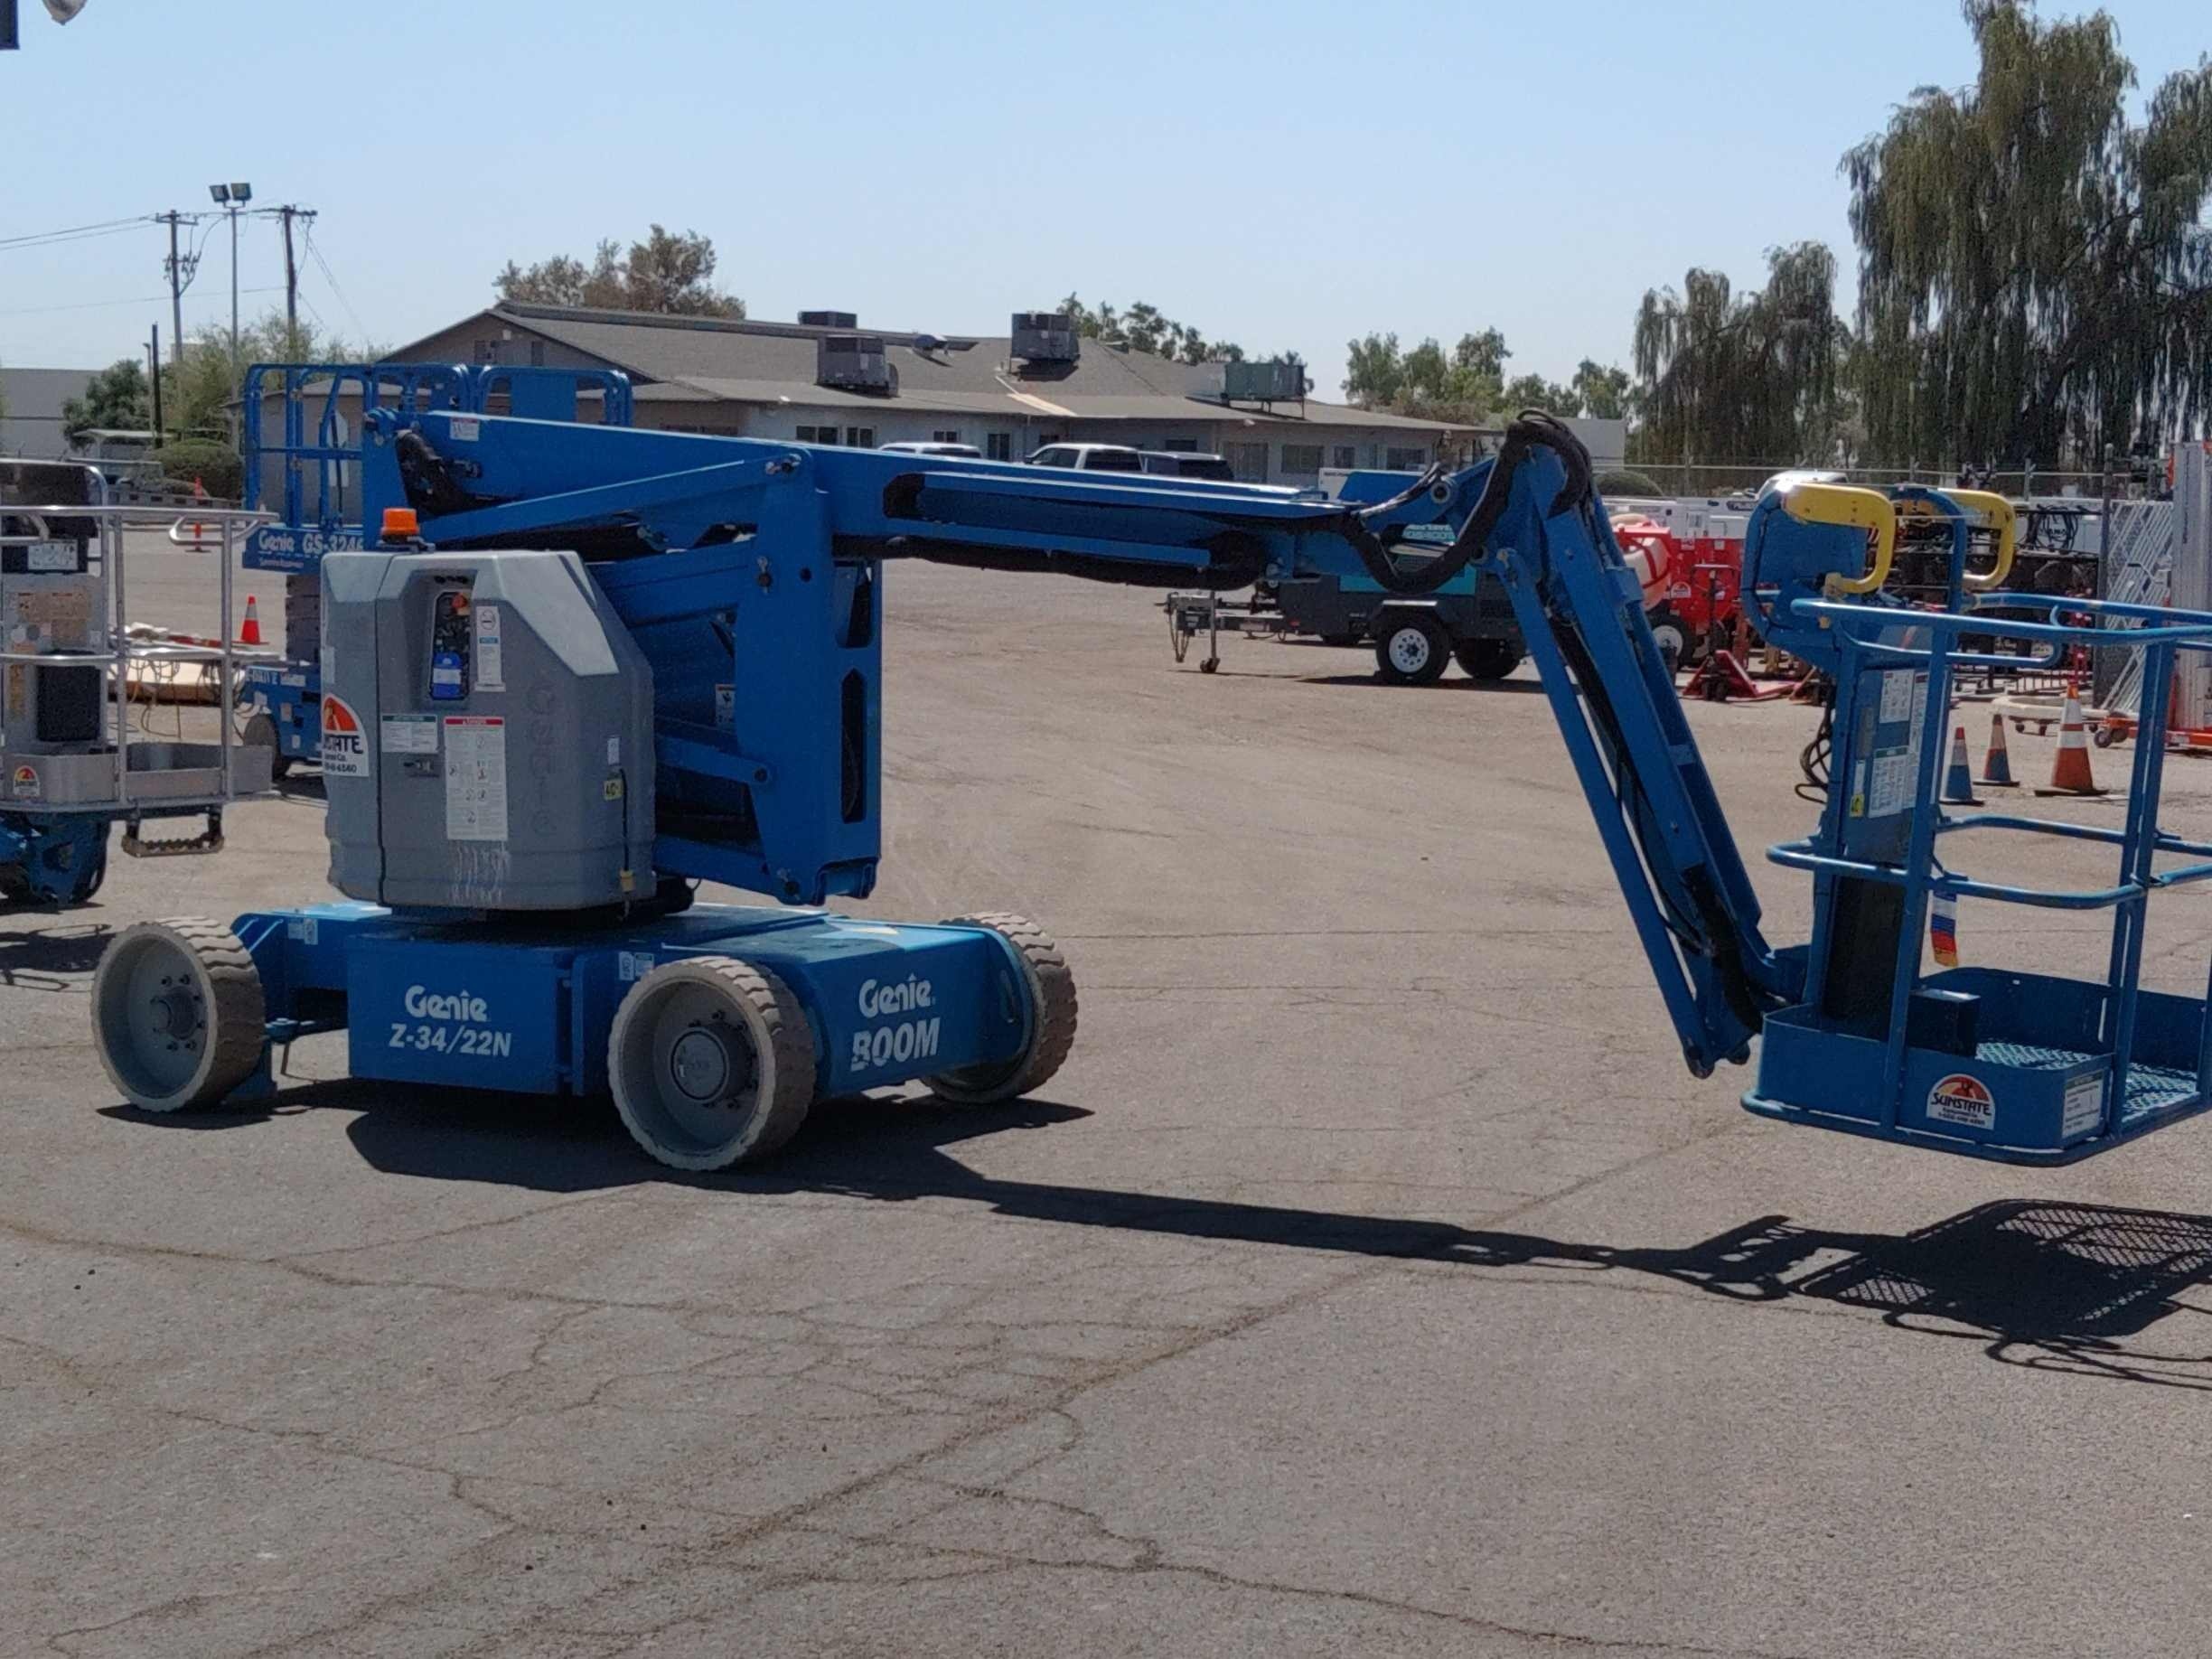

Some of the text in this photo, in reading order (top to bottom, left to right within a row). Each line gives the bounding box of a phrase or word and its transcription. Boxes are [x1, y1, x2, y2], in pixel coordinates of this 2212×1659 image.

[258, 530, 295, 552] Genie
[405, 984, 488, 1022] Genie
[858, 972, 932, 1018] Genie
[389, 1023, 511, 1057] Z-34/22N
[850, 1017, 941, 1072] BOOM
[1931, 1092, 1992, 1117] SUNSTATE
